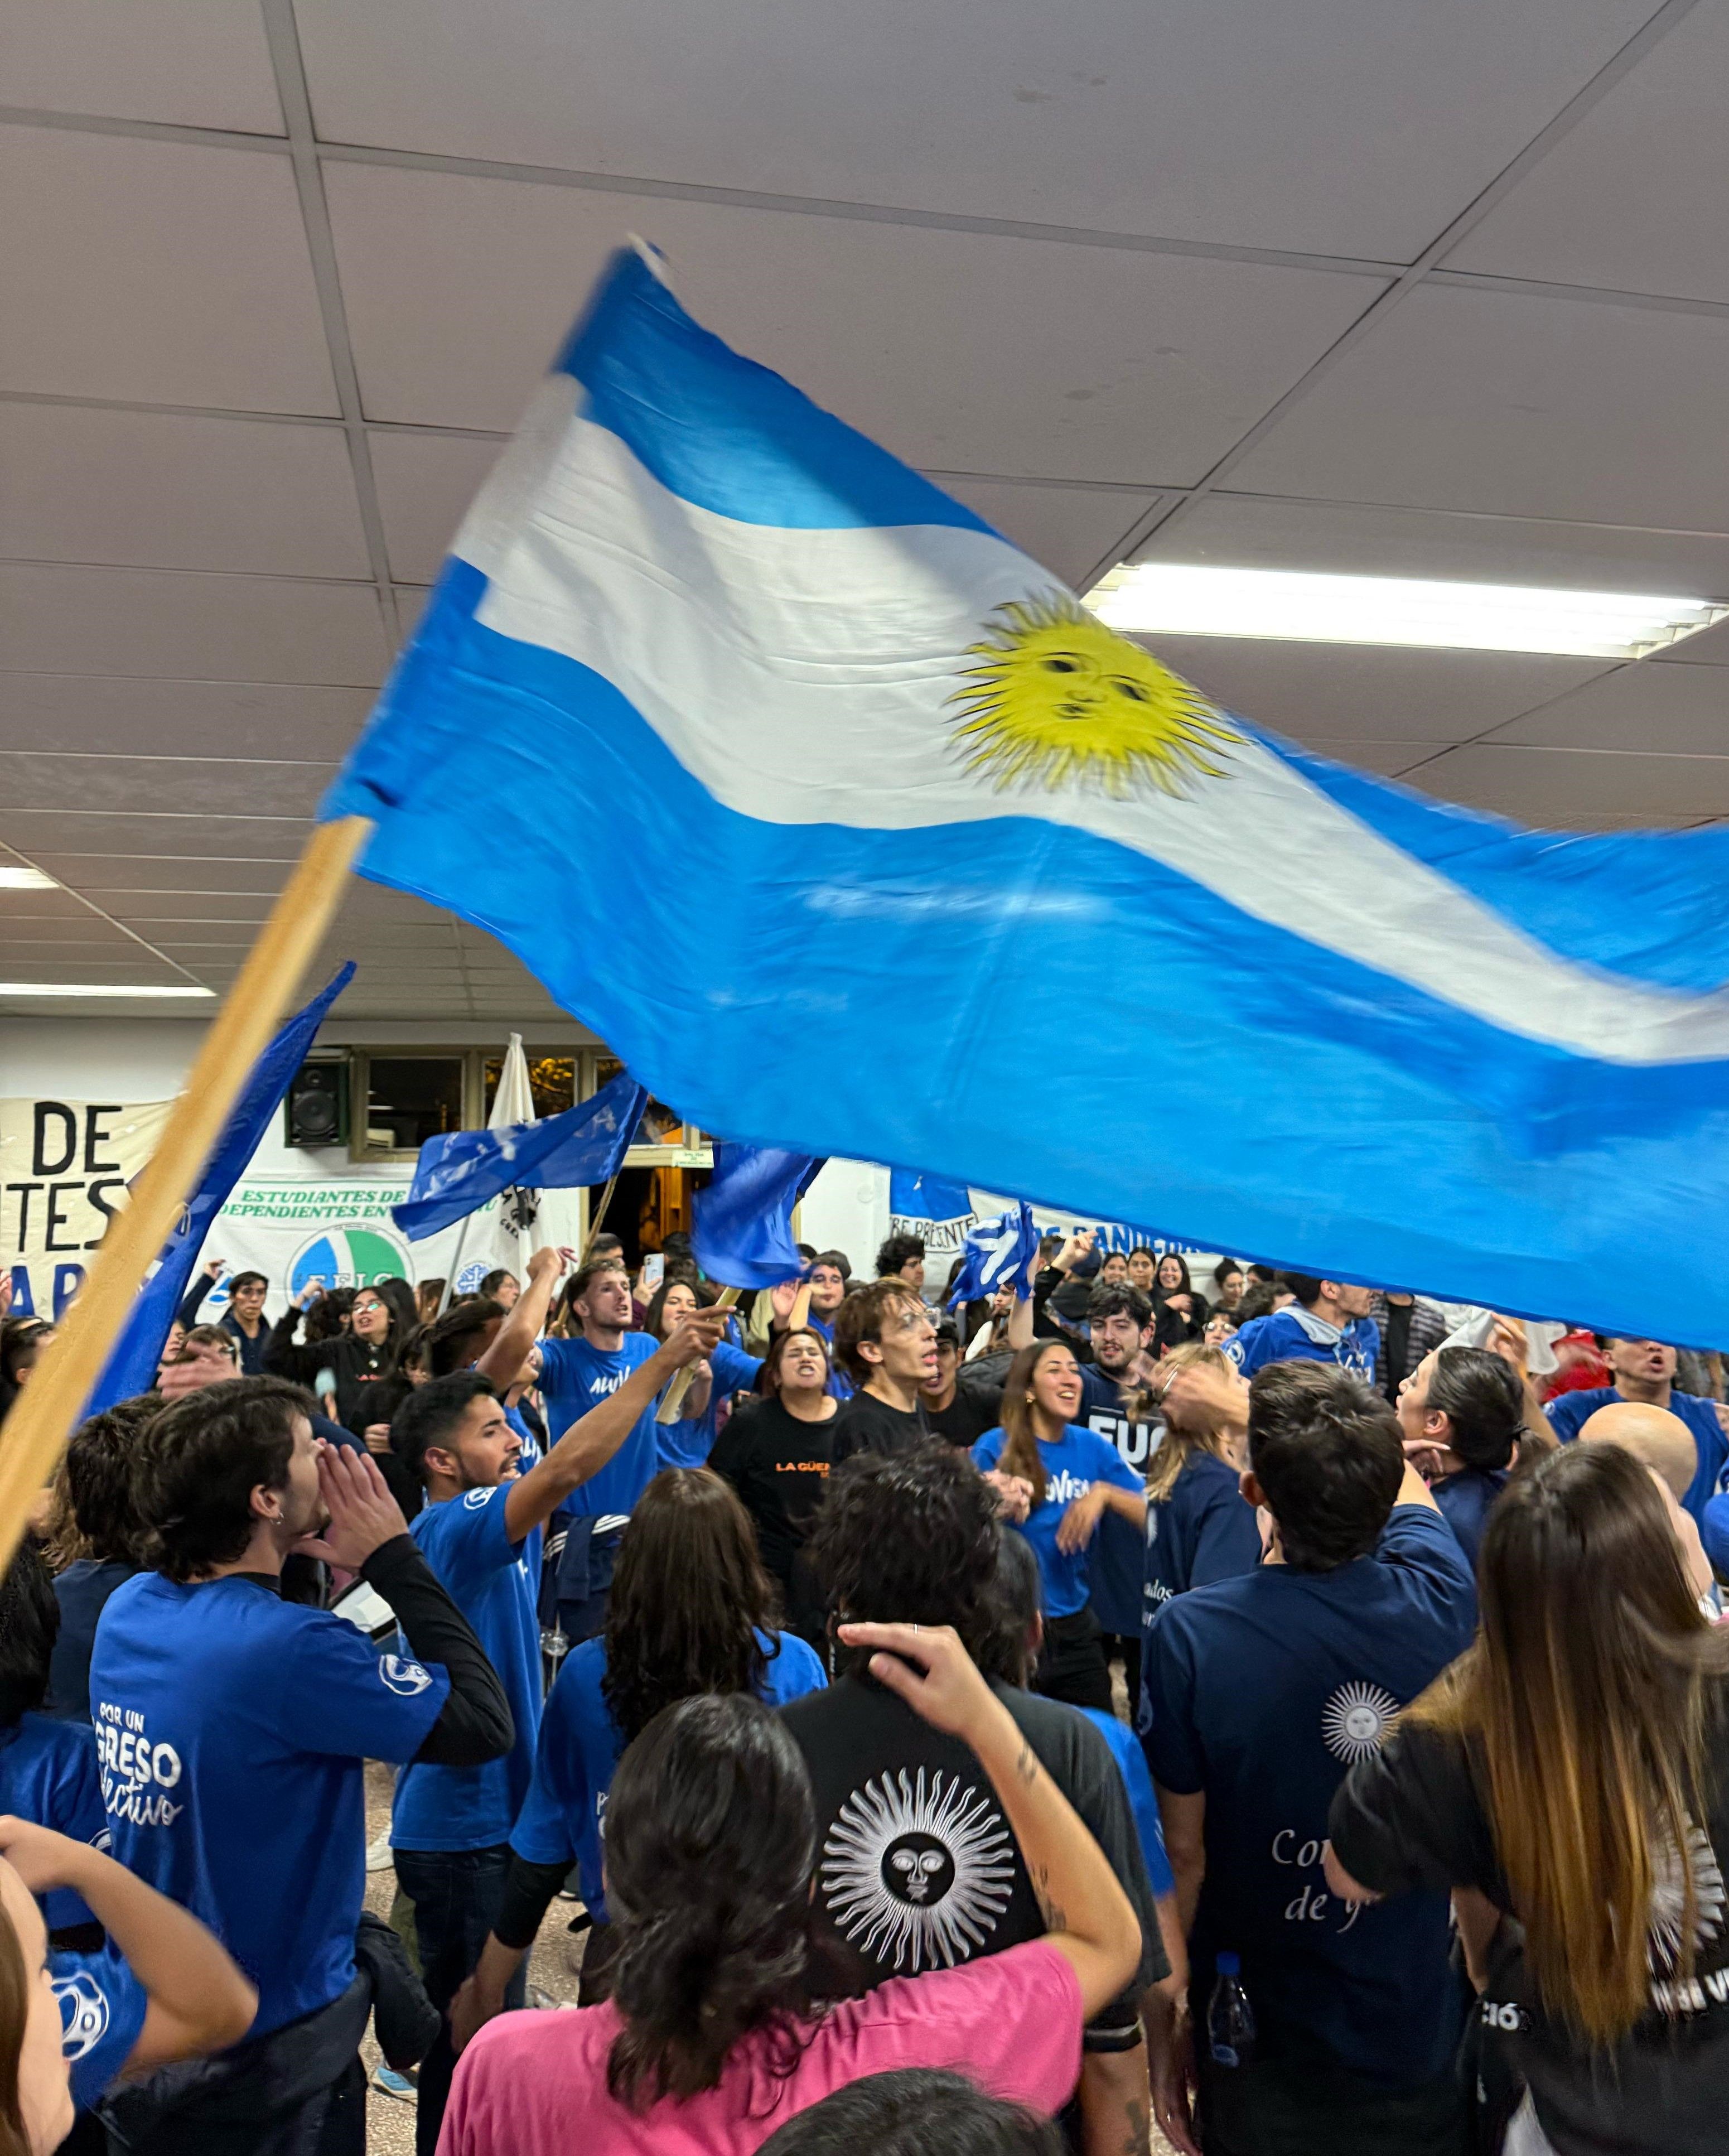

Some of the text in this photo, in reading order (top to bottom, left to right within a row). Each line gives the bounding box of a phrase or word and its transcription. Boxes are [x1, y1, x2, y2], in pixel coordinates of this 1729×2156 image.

[33, 1101, 122, 1176] DE
[242, 1190, 407, 1203] ESTUDIANTES DE
[0, 1179, 124, 1252] TES
[776, 1462, 796, 1472] LA
[100, 1702, 144, 1733] POR UN
[91, 1715, 182, 1788] GRESO
[1284, 1885, 1328, 1921] de
